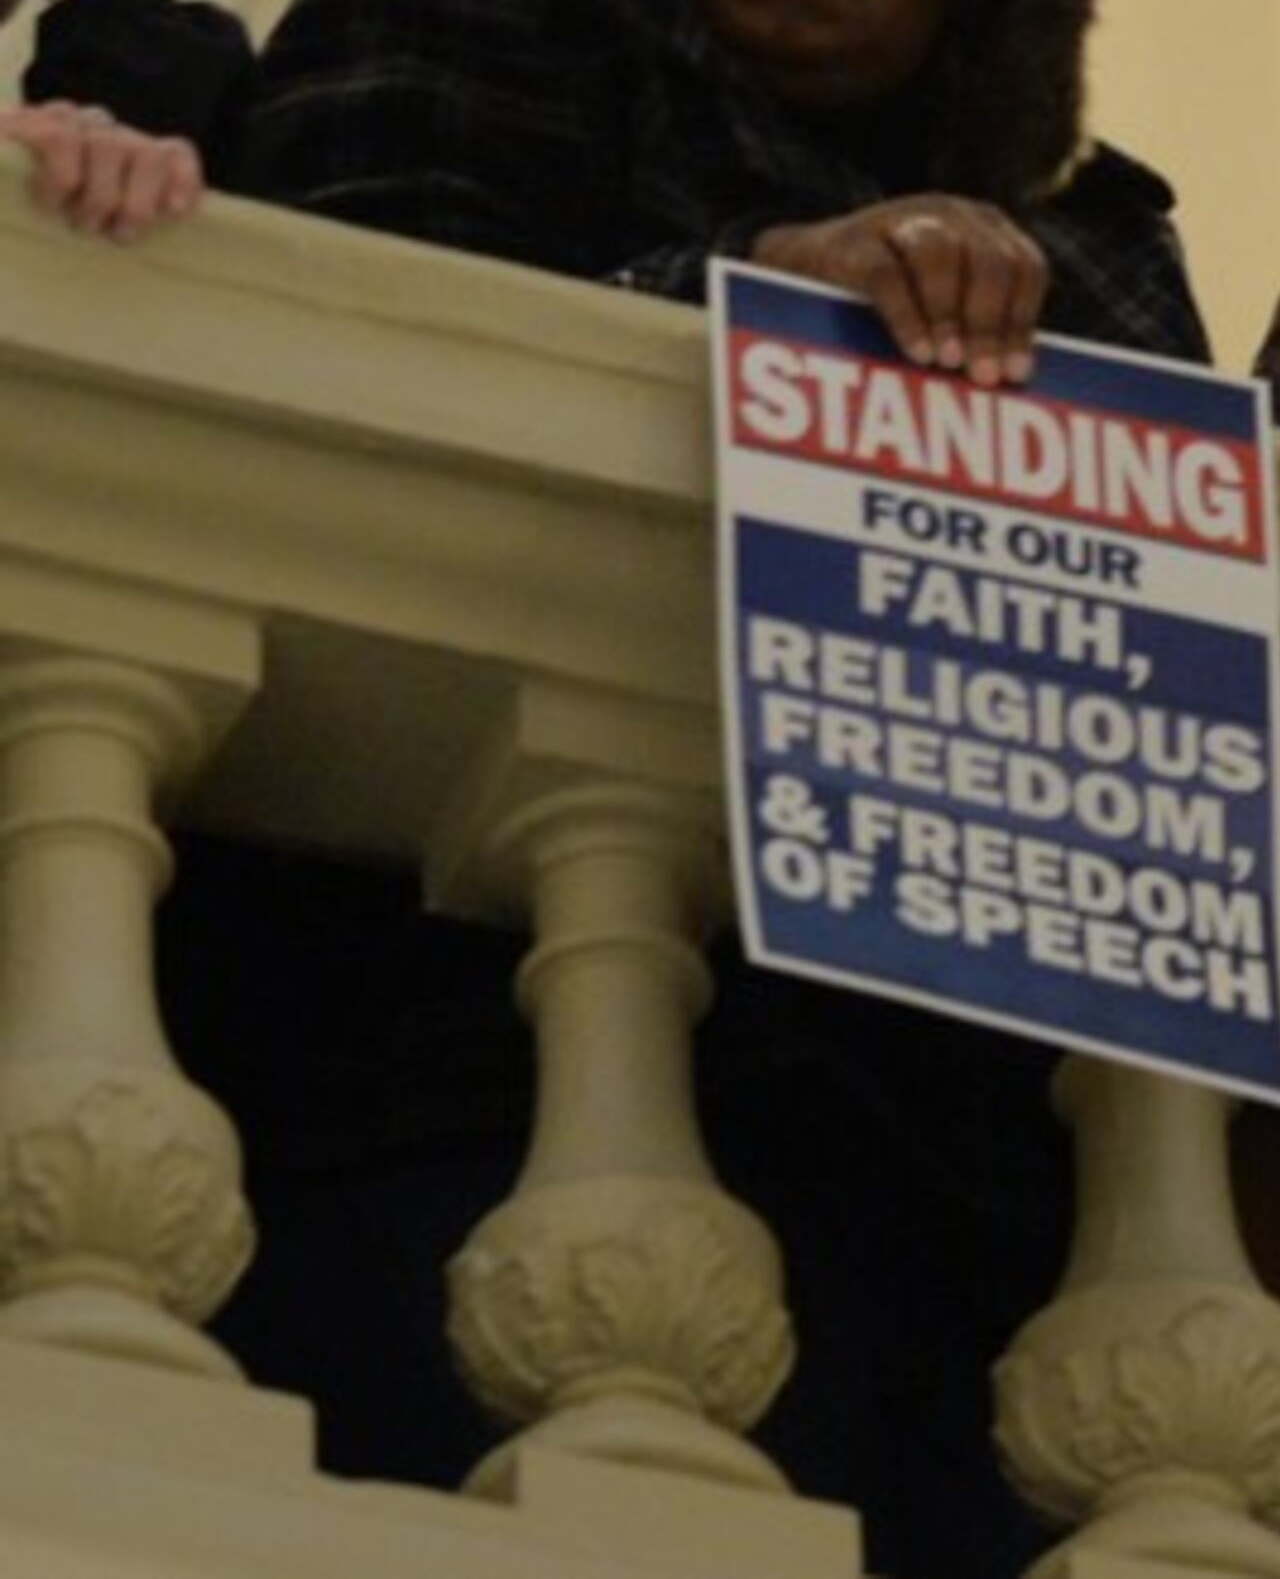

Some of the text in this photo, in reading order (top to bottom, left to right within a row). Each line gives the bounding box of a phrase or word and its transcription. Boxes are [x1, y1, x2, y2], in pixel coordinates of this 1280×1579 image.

[739, 342, 1249, 543] STANDING
[857, 553, 1151, 689] FAITH,
[861, 489, 1142, 588] FOR OUR
[749, 618, 1266, 793] RELIGIOUS
[760, 693, 1254, 879] FREEDOM,
[760, 773, 1265, 953] & FREEDOM
[760, 840, 1273, 1022] OF SPEECH
